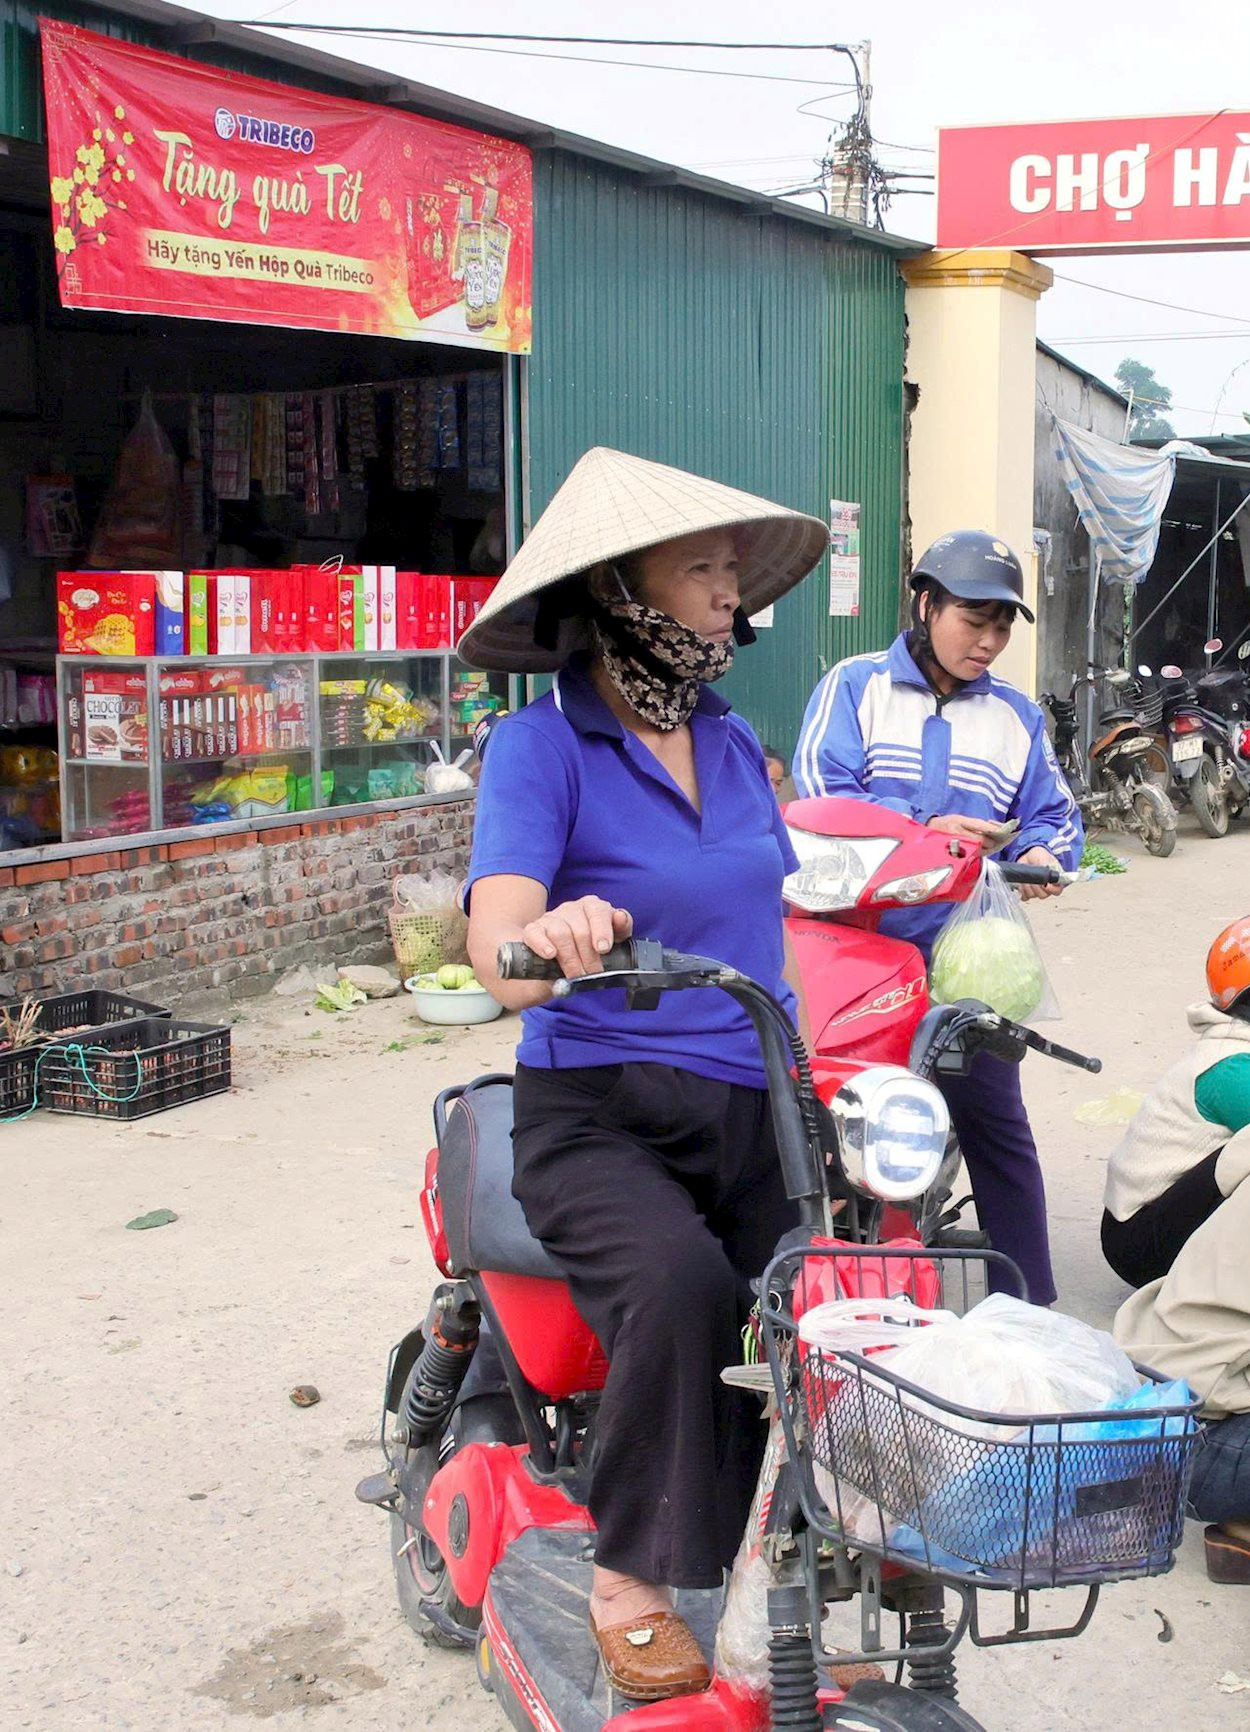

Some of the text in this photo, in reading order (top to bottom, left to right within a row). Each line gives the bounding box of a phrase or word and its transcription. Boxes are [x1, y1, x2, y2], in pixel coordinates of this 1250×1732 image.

[238, 114, 314, 154] TRIBECO
[153, 128, 363, 234] Tặng quà Tết
[1010, 143, 1150, 221] CHỢ
[148, 240, 374, 285] Hãy tặng Yến Hộp Quà Tribeco
